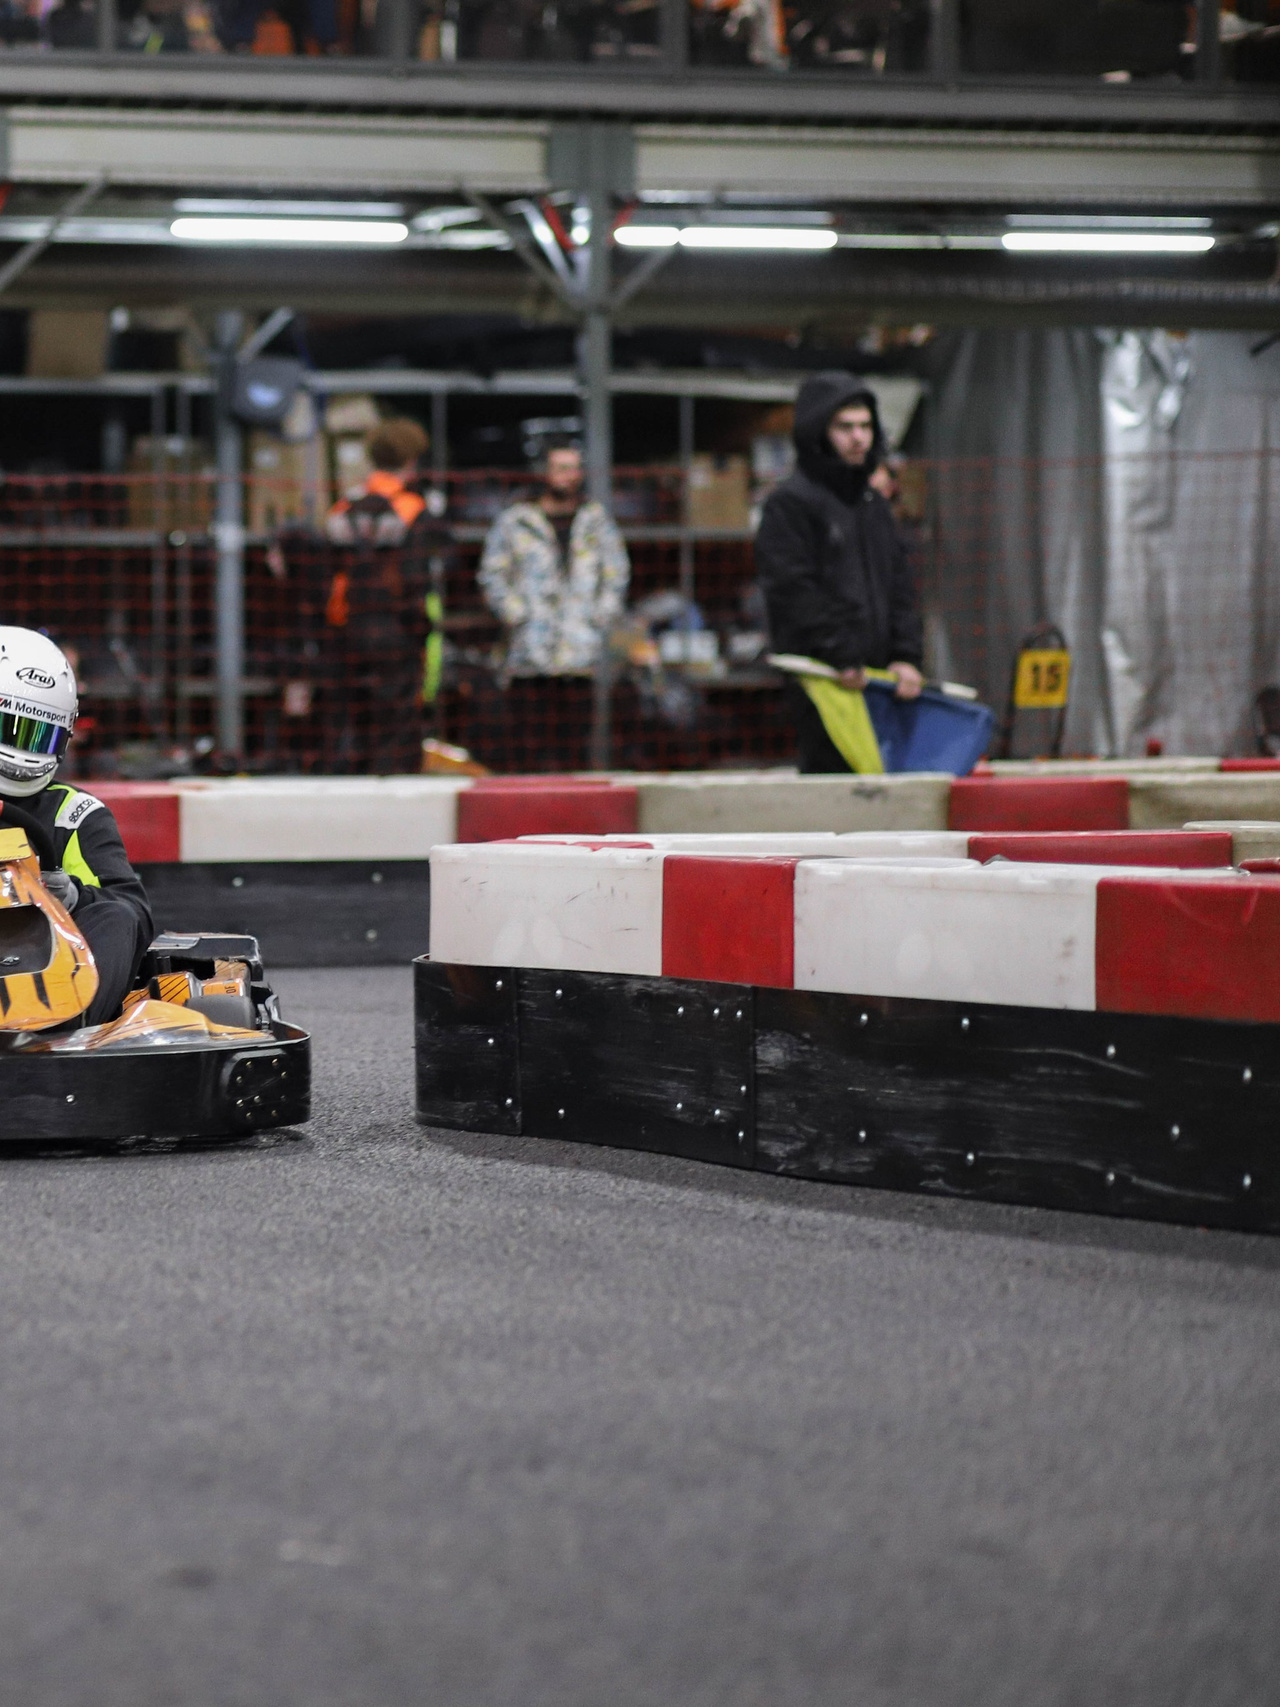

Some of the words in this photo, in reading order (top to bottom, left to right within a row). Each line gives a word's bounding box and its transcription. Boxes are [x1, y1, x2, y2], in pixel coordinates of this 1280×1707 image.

[18, 668, 52, 685] Arai
[1031, 661, 1062, 693] 15
[14, 701, 67, 724] Motorsport
